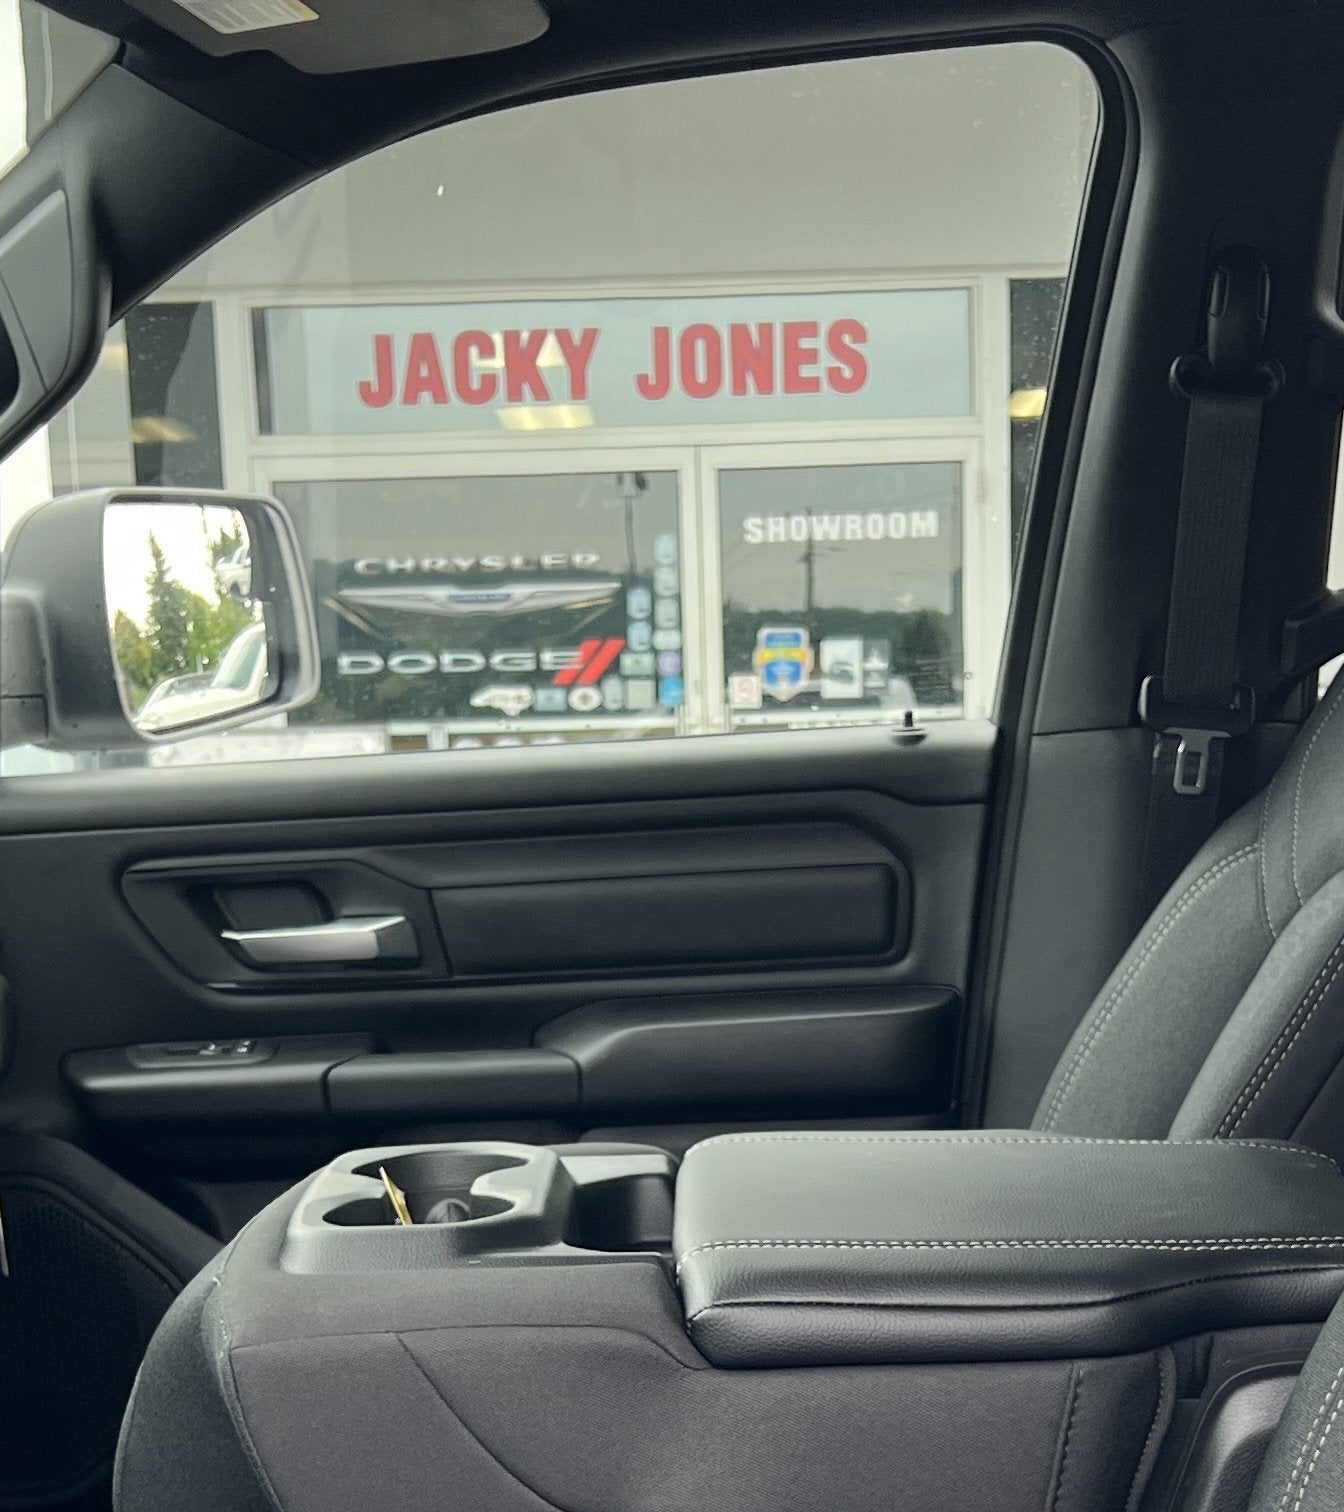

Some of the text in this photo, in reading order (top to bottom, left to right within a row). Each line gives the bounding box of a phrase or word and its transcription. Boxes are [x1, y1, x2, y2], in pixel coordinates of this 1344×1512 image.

[359, 318, 869, 407] JACKY JONES
[743, 511, 939, 544] SHOWROOM
[354, 552, 600, 575] CHRYSLER
[337, 650, 585, 675] DODGE
